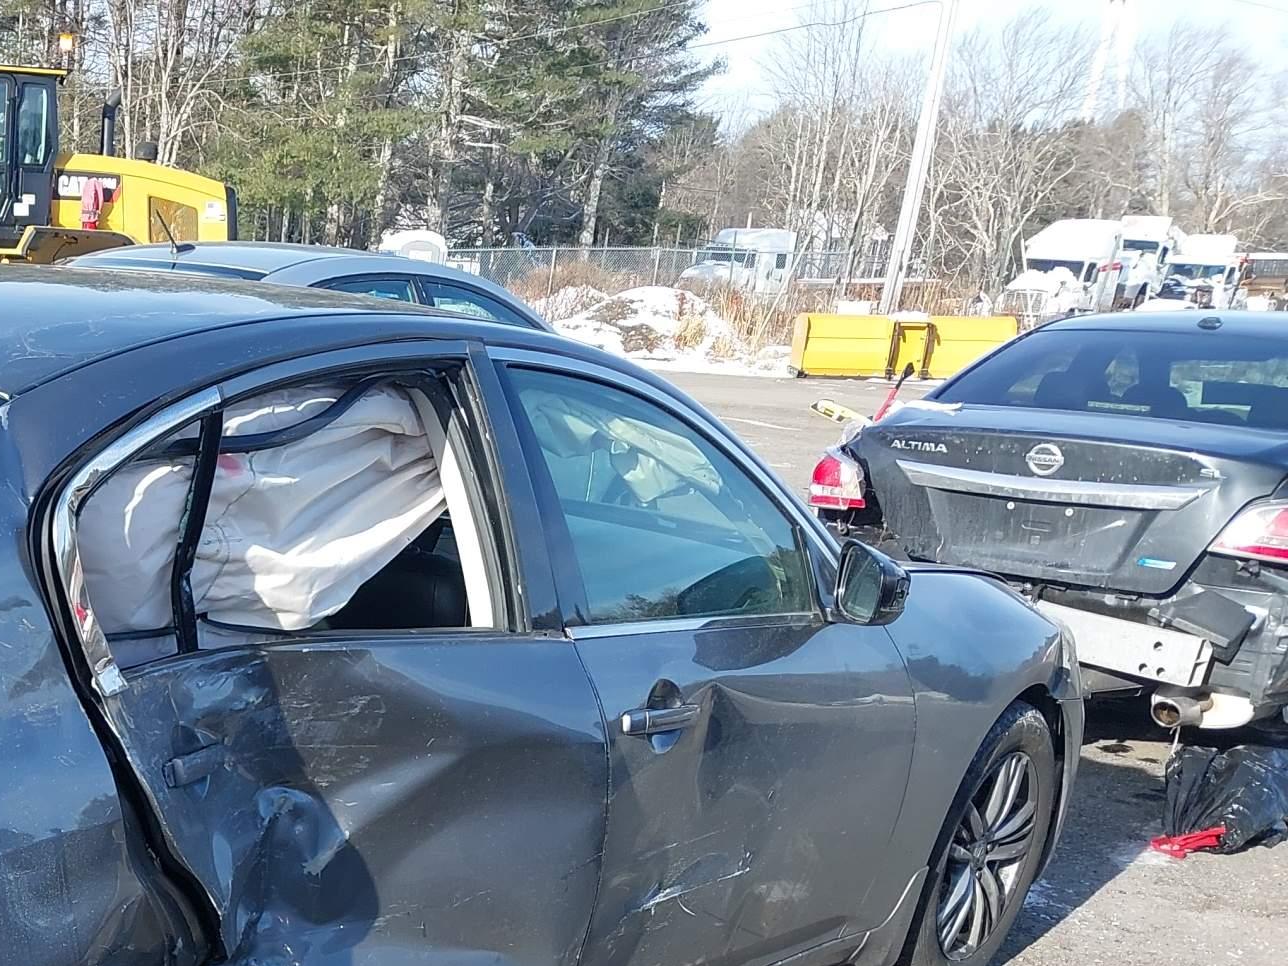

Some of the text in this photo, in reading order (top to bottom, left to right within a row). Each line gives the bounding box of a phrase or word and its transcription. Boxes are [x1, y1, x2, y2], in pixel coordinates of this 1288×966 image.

[58, 174, 88, 196] CAT
[890, 439, 948, 453] ALTIMA
[1027, 454, 1061, 464] NISSAN
